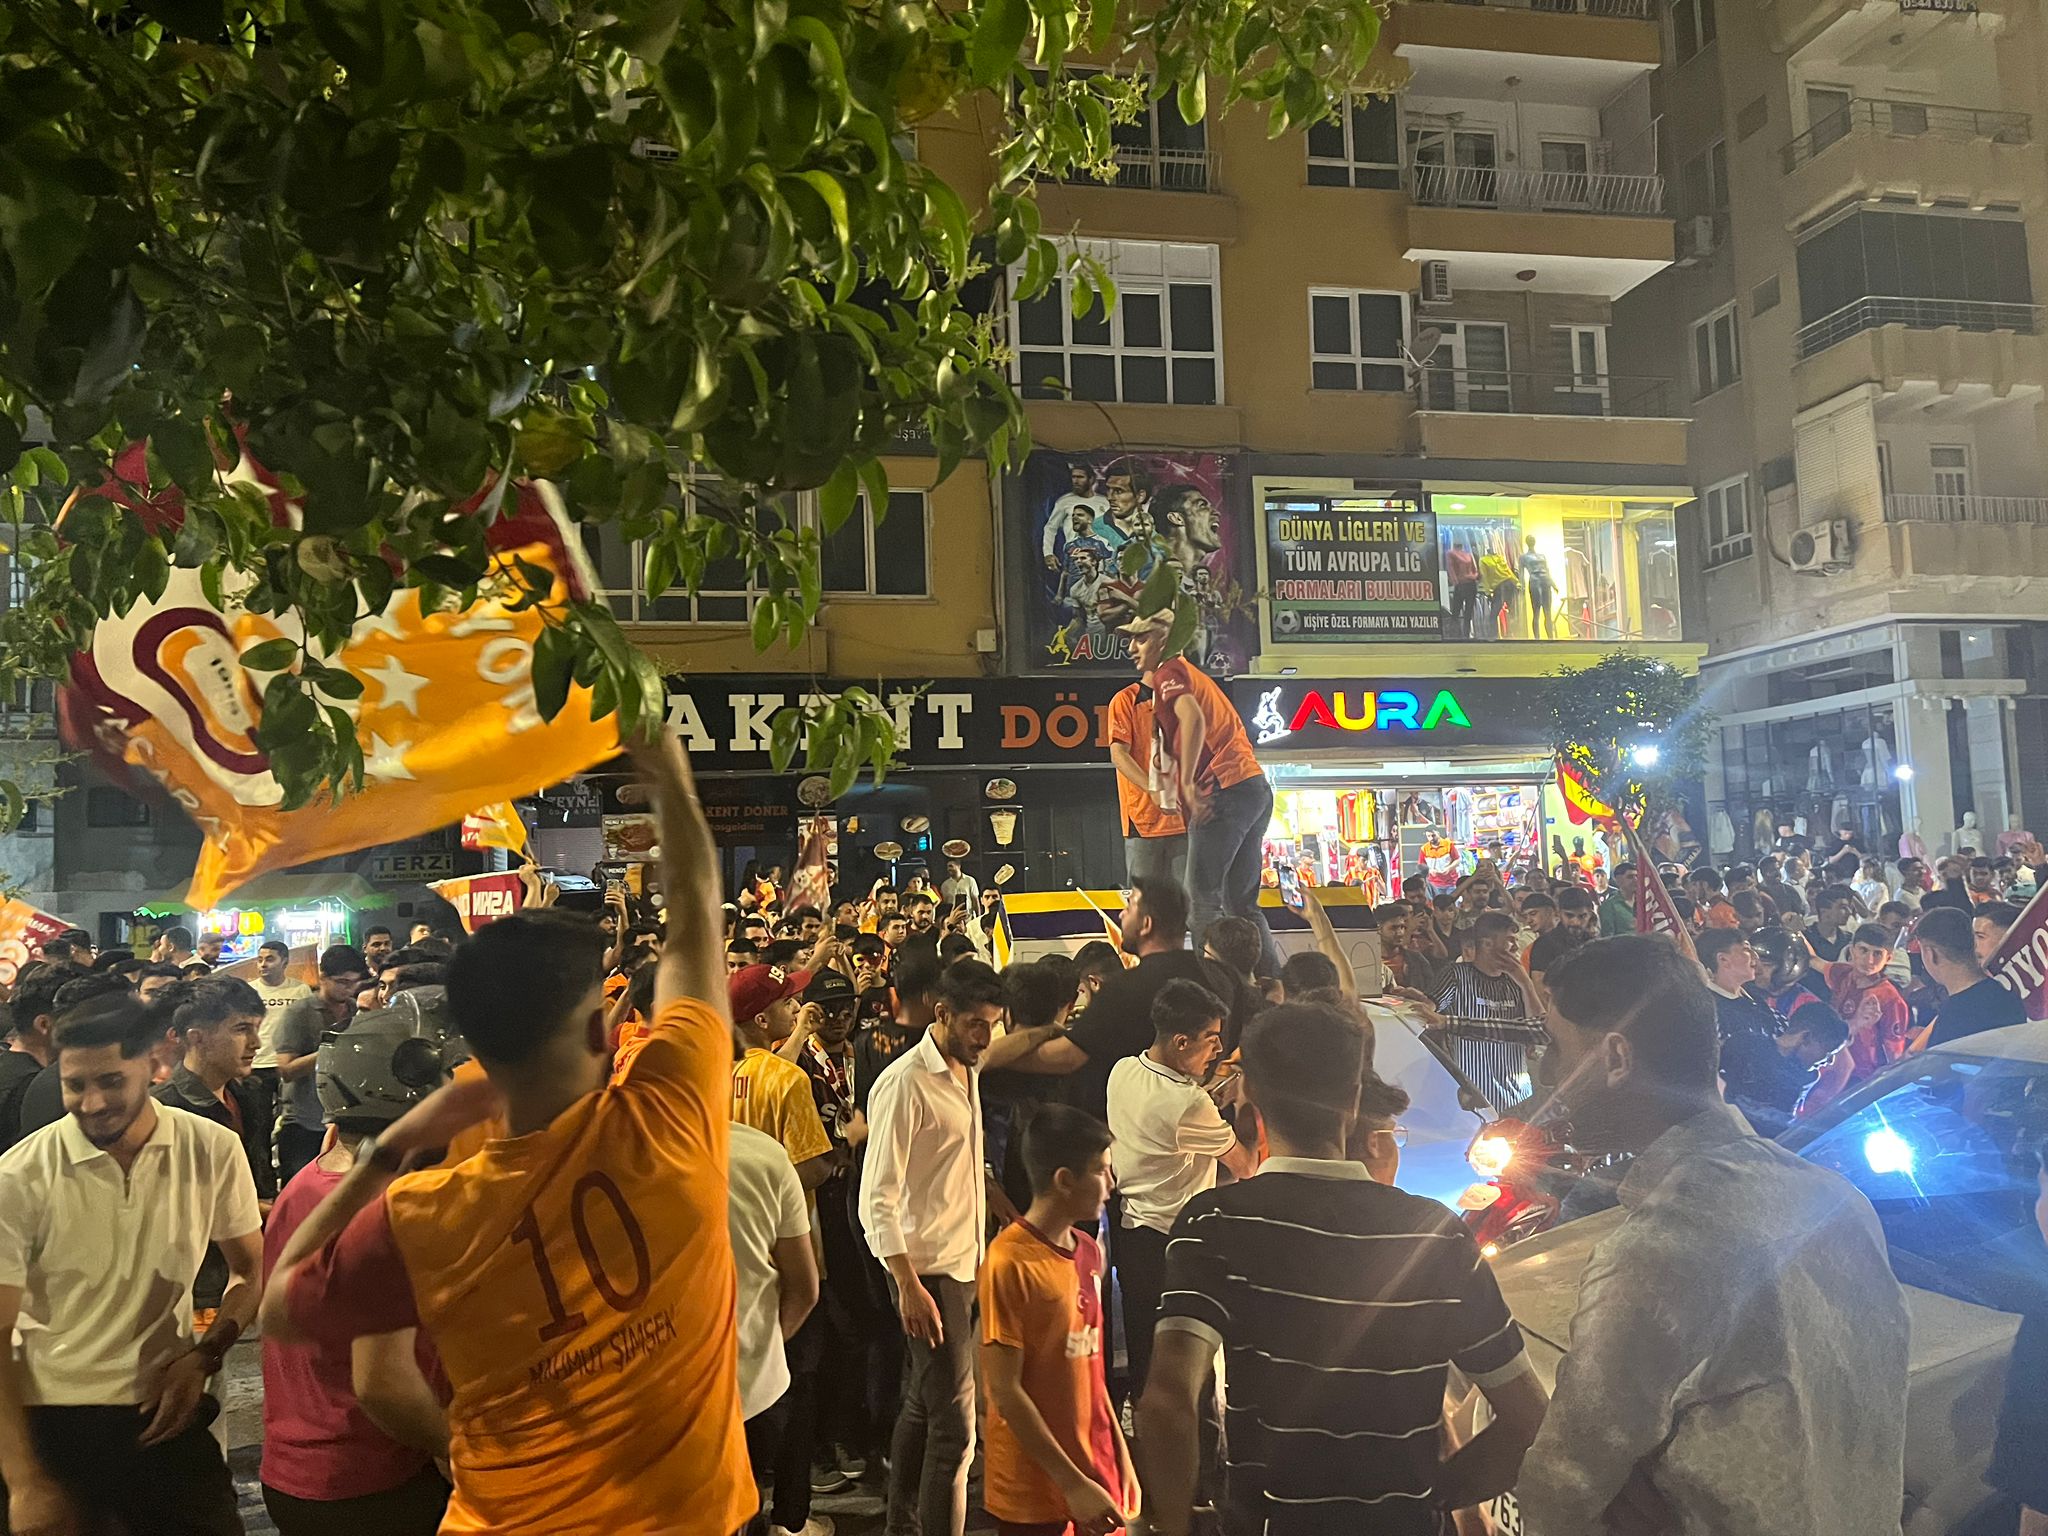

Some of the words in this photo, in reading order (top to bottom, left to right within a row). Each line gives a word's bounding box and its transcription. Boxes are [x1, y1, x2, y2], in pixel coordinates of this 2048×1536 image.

[1279, 515, 1333, 542] DÜNYA
[1338, 516, 1400, 542] LİGLERİ
[1404, 521, 1425, 542] VE
[1285, 546, 1322, 571] TÜM
[1327, 551, 1391, 572] AVRUPA
[1396, 547, 1421, 572] LİG
[1276, 579, 1362, 600] FORMALARI
[1365, 580, 1434, 600] BULUNUR
[1304, 614, 1329, 631] KİŞİYE
[1331, 613, 1350, 628] ÖZEL
[1352, 616, 1389, 628] FORMAYA
[1391, 616, 1408, 628] YAZI
[1409, 616, 1439, 628] YAZILIR
[1071, 633, 1135, 660] AUR
[1001, 692, 1109, 749] DÖ
[1288, 689, 1473, 731] AURA
[374, 855, 451, 871] TERZİ
[511, 1170, 652, 1343] 10
